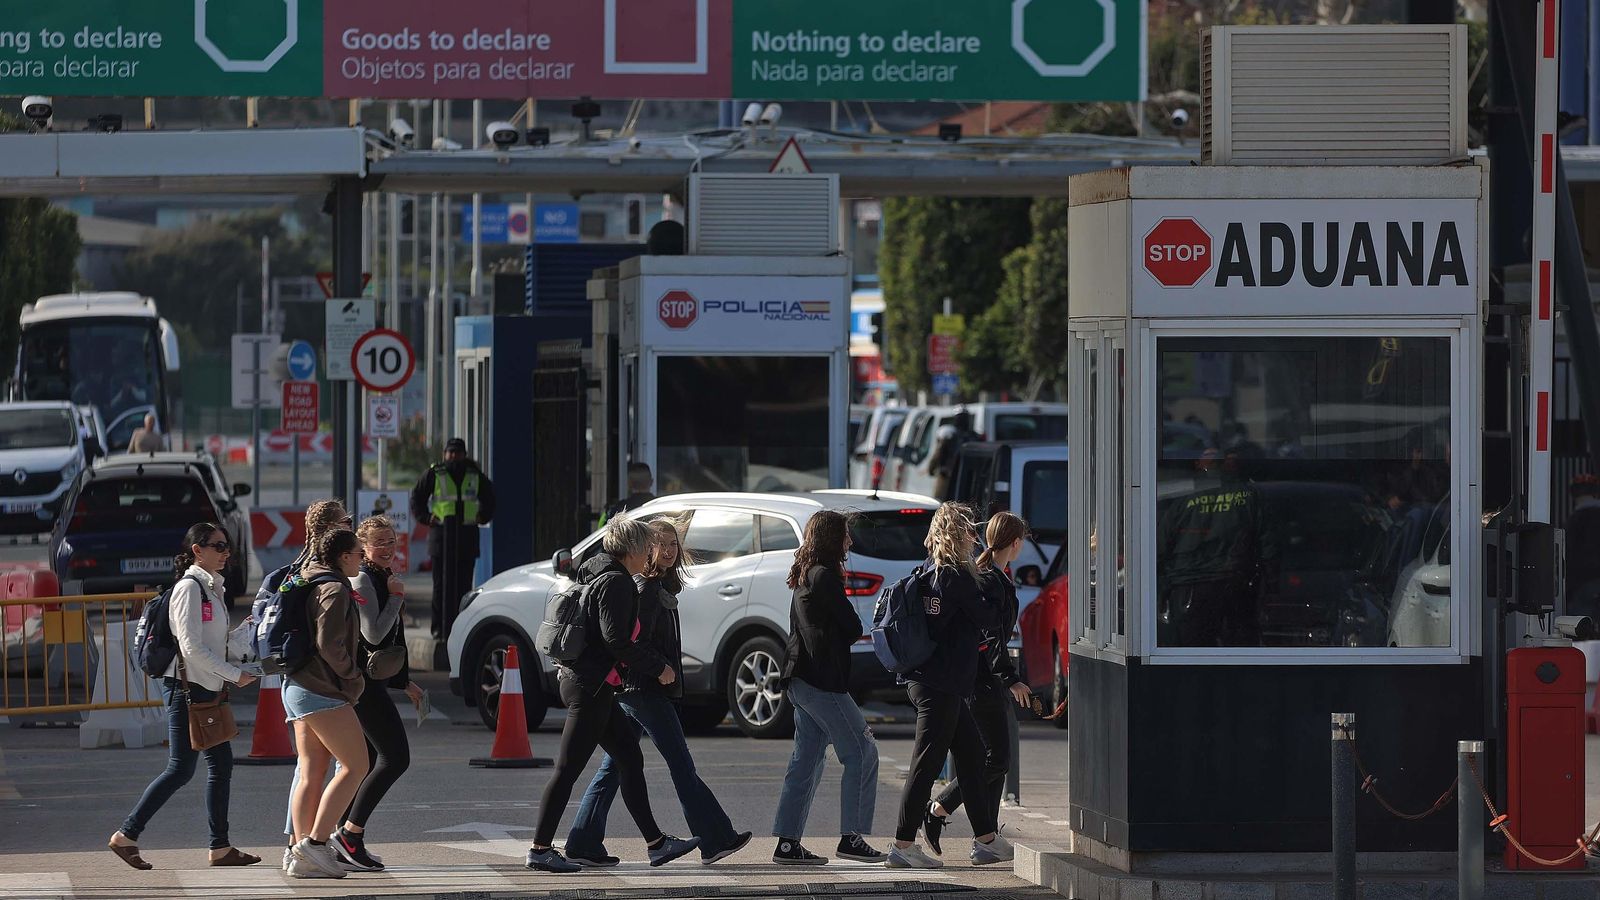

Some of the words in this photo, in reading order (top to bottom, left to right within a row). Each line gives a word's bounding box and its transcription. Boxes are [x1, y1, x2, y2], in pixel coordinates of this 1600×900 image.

[40, 31, 66, 48] to
[74, 26, 162, 48] declare
[341, 28, 421, 50] Goods
[428, 30, 455, 50] to
[463, 28, 551, 50] declare
[752, 30, 850, 57] Nothing
[858, 33, 885, 52] to
[892, 31, 981, 52] declare
[54, 54, 139, 78] declarar
[341, 57, 425, 84] Objetos
[434, 61, 481, 84] para
[489, 58, 575, 80] declarar
[752, 60, 808, 81] Nada
[816, 64, 864, 86] para
[872, 60, 958, 82] declarar
[1149, 243, 1206, 262] STOP
[1214, 221, 1470, 288] ADUANA
[661, 301, 695, 319] STOP
[703, 301, 803, 313] POLICIA
[764, 313, 831, 321] NACIONAL
[363, 347, 402, 374] 10
[291, 384, 311, 395] NEW
[288, 395, 312, 406] ROAD
[284, 408, 316, 419] LAYOUT
[285, 419, 314, 430] AHEAD
